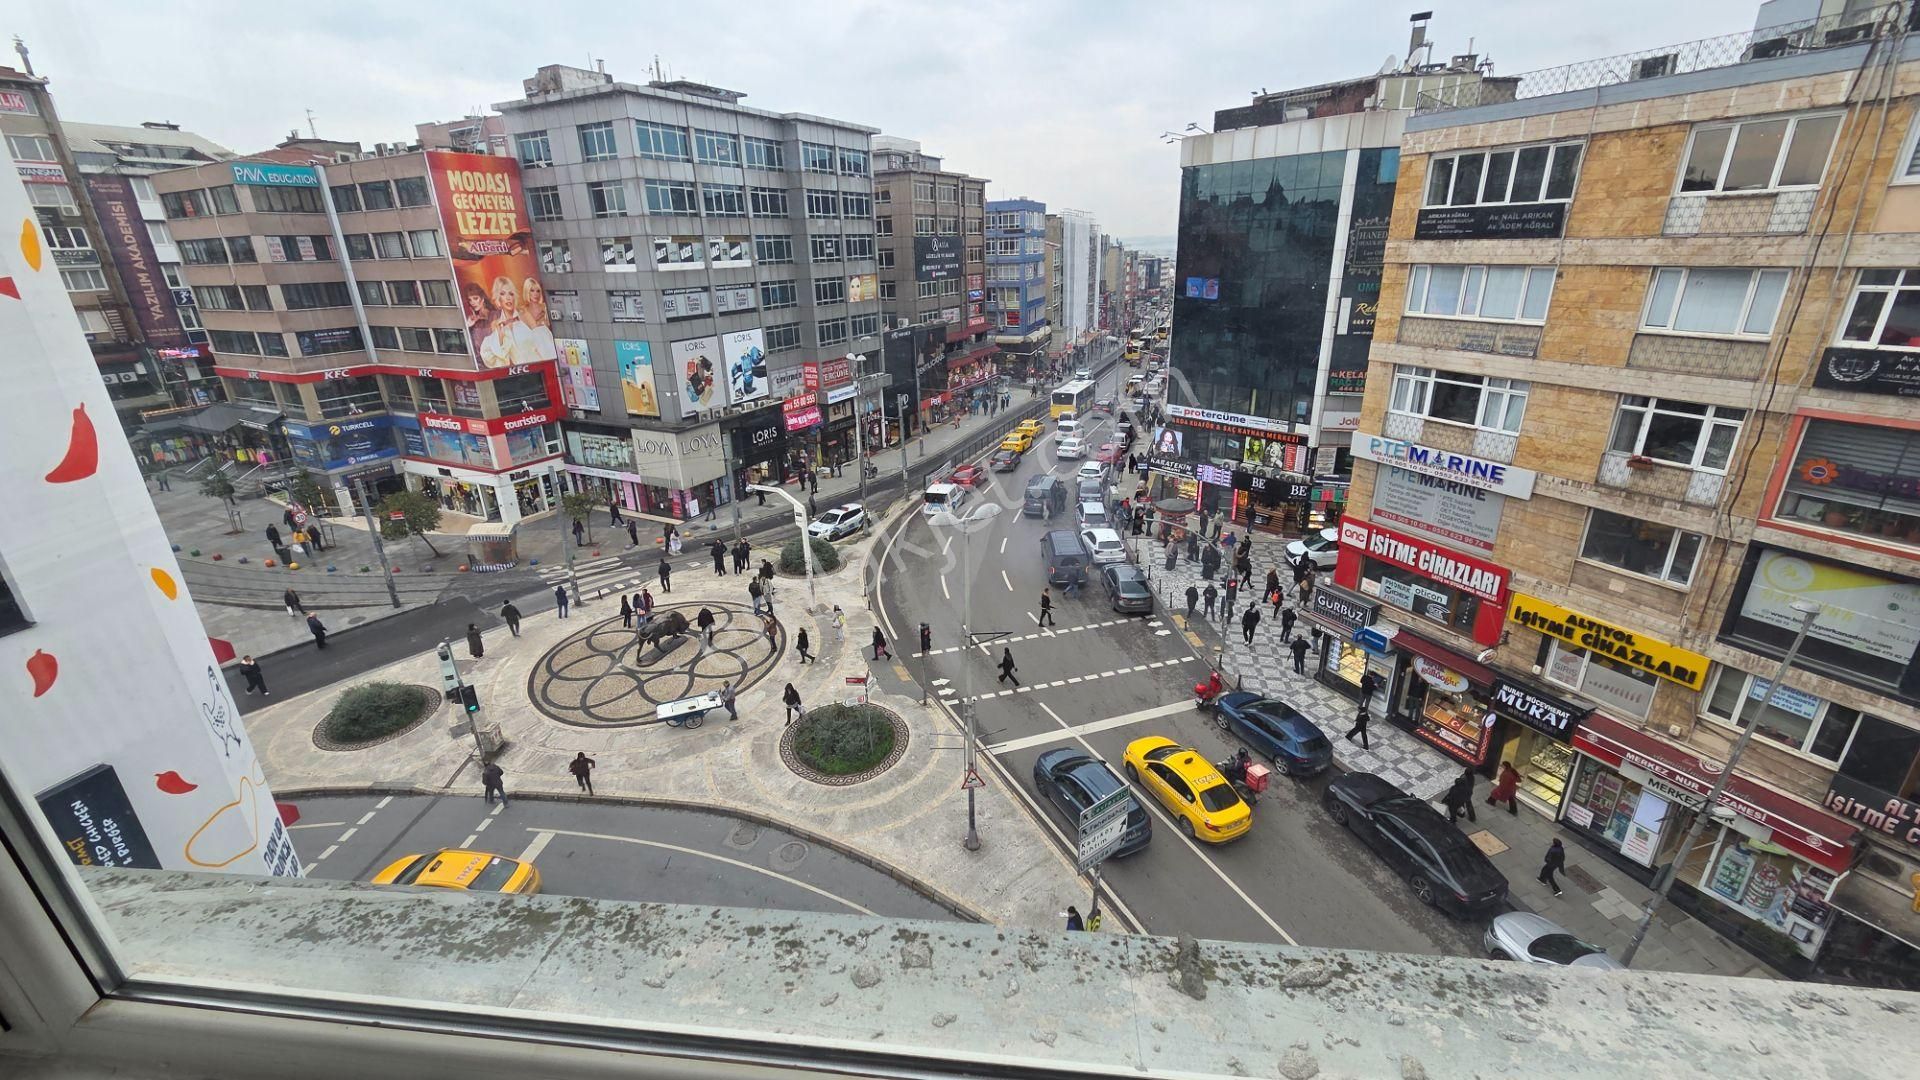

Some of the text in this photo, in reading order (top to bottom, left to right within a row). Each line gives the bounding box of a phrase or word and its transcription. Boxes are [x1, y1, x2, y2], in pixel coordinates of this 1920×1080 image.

[233, 166, 318, 185] PAVA EDUCATION
[447, 170, 511, 193] MODASI
[453, 193, 515, 211] GEÇMEYEN
[456, 212, 517, 235] LEZZET
[139, 272, 164, 320] YAZILIM
[324, 369, 350, 380] KFC
[418, 368, 433, 378] KFC
[509, 364, 530, 376] KFC
[504, 414, 547, 430] touristica
[1184, 407, 1247, 424] protercüme
[342, 421, 375, 432] TURKCELL
[752, 426, 778, 444] LORIS
[1223, 426, 1237, 435] SAÇ
[1266, 432, 1300, 443] MERKEZİ
[637, 439, 674, 457] LOYA
[680, 432, 720, 455] LOYA
[1370, 437, 1406, 457] PTE
[1252, 477, 1267, 489] BE
[1291, 485, 1308, 497] BE
[1420, 473, 1486, 501] MARINE
[1370, 529, 1418, 566] İŞİTME
[1418, 549, 1501, 596] CİHAZLARI
[1415, 588, 1443, 603] oticon
[1565, 614, 1636, 647] ALTIYOL
[1514, 606, 1698, 685] İŞİTME CİHAZLARI
[1502, 684, 1571, 719] MURAT MÜCEVHERAT
[1626, 751, 1669, 776] MERKEZ
[1675, 774, 1700, 791] NUR
[70, 800, 102, 842] CHICKEN
[1081, 826, 1114, 849] Kadıköy
